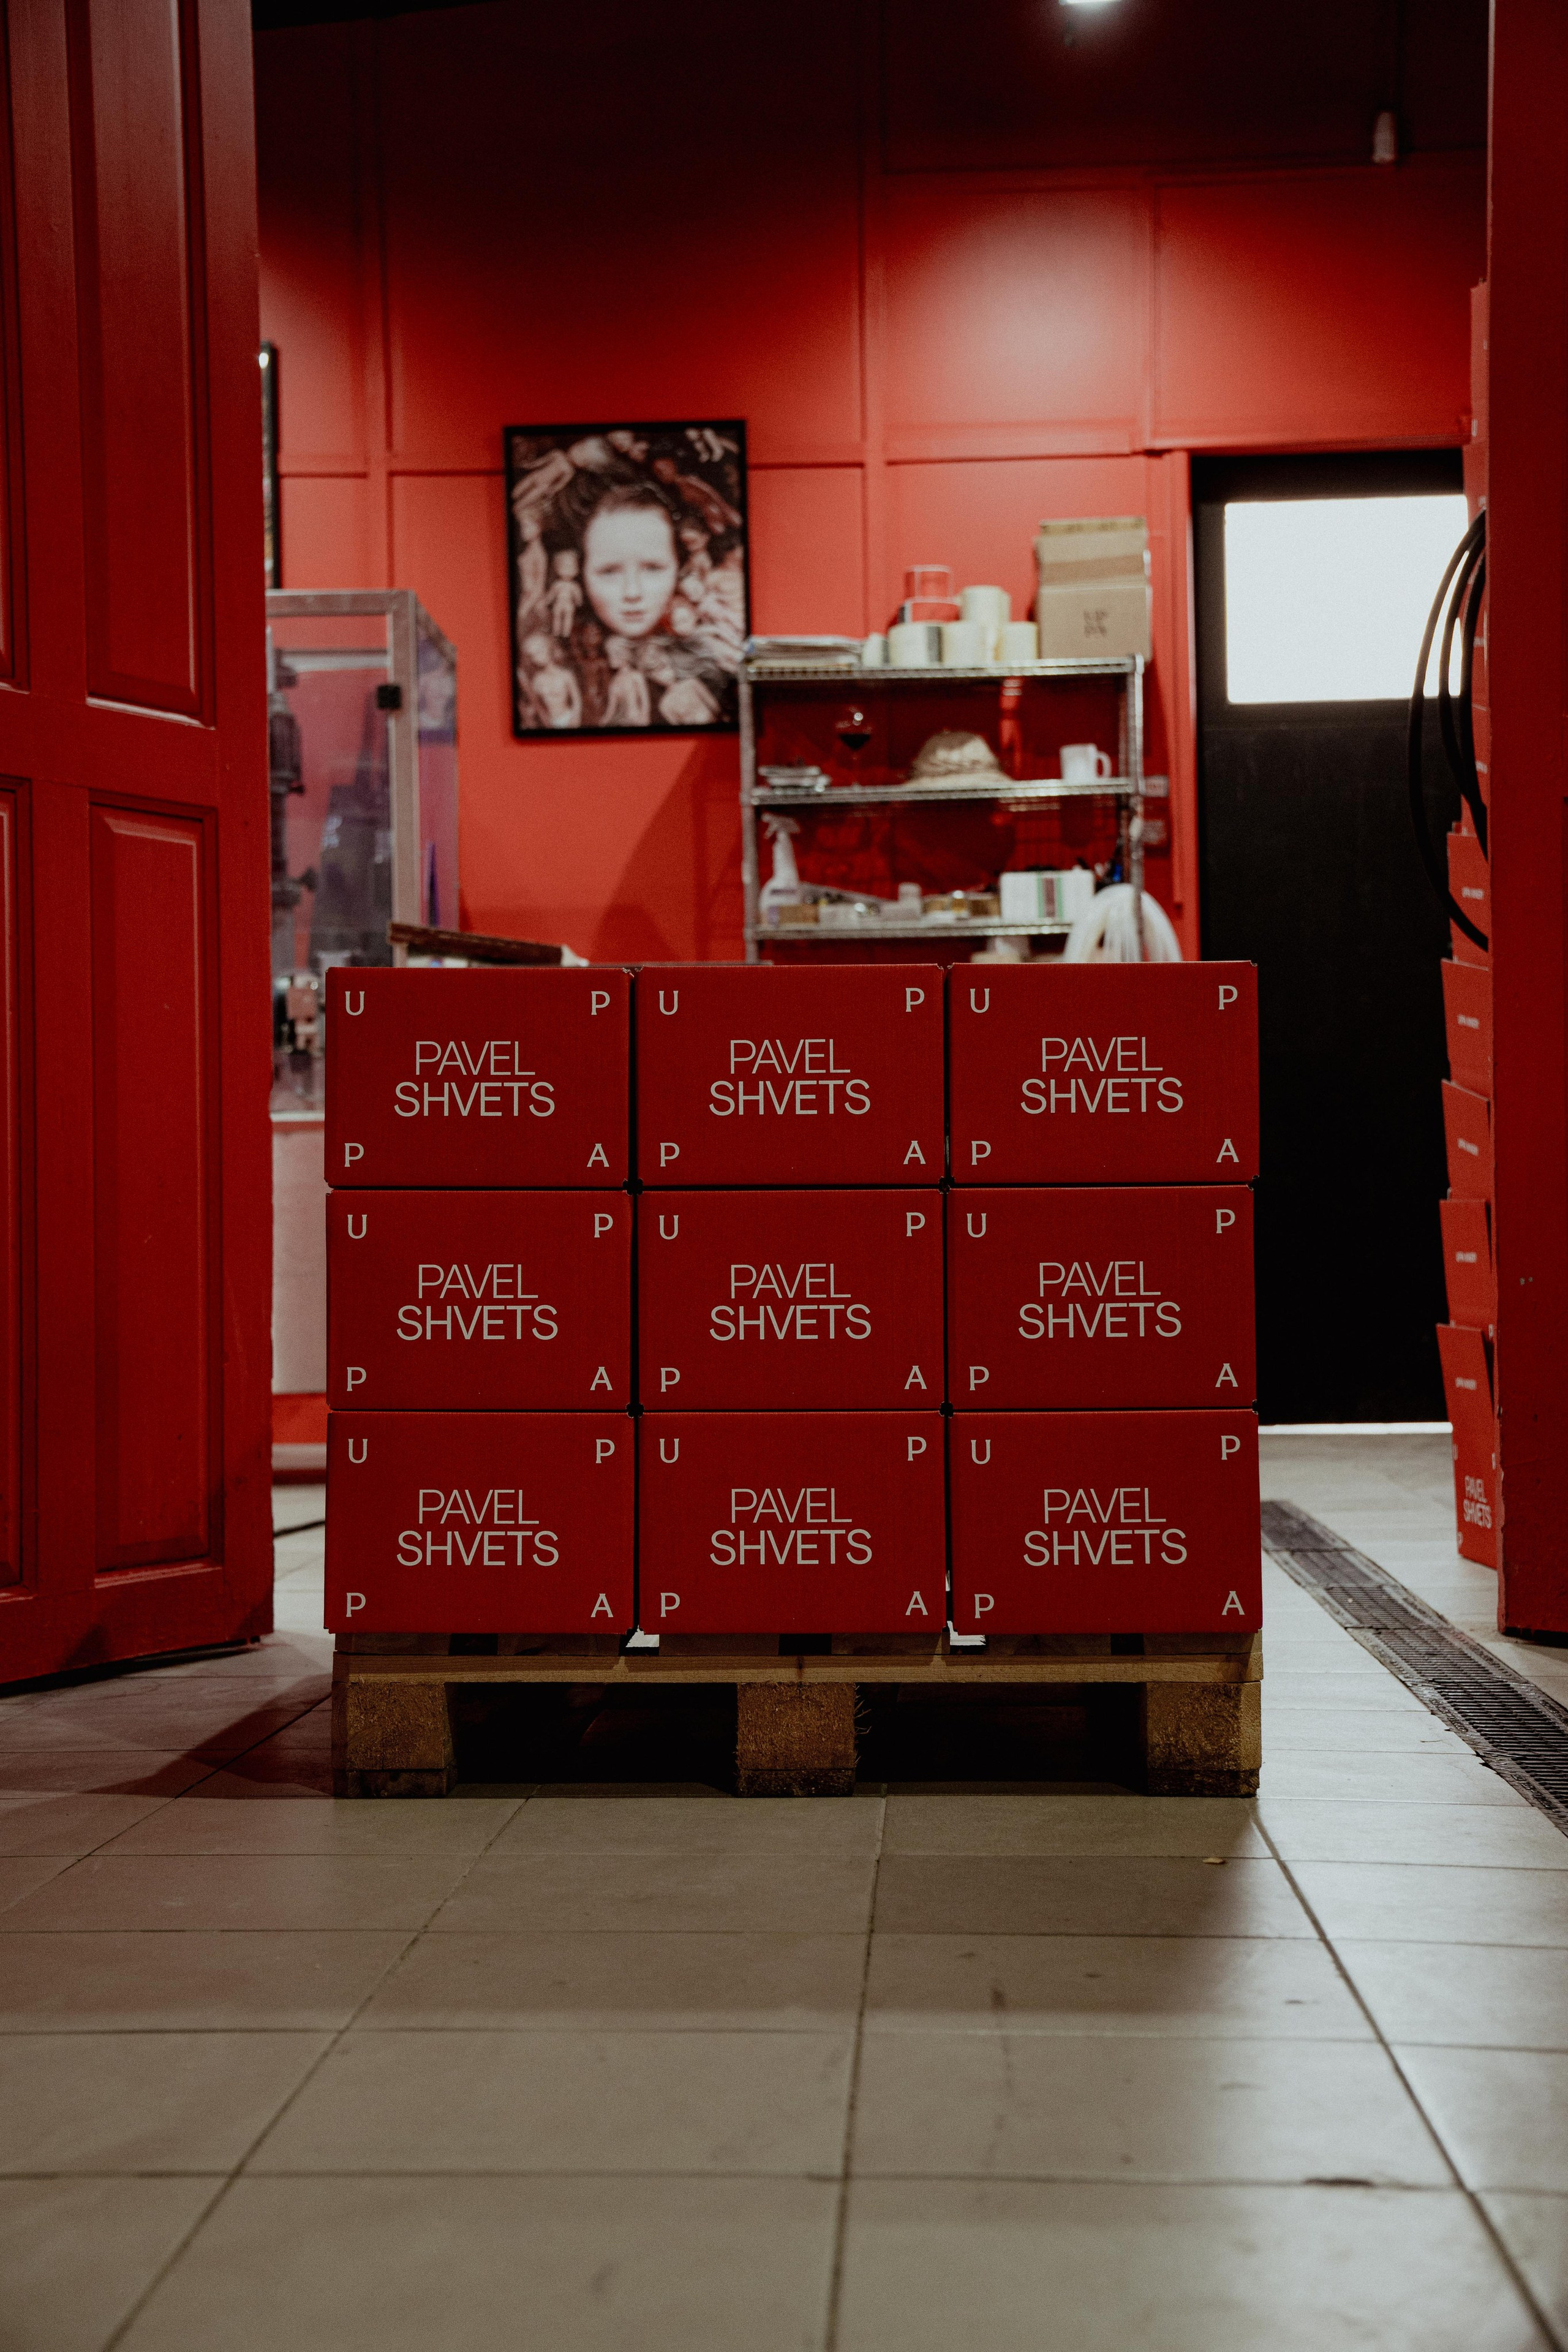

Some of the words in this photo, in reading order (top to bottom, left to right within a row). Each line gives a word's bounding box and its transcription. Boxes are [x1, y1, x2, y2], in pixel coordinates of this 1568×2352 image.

[345, 991, 365, 1016] U
[590, 990, 611, 1016] P
[658, 990, 679, 1016] U
[905, 987, 925, 1012] P
[970, 988, 990, 1014] U
[1218, 985, 1238, 1010] P
[415, 1041, 536, 1076] PAVEL
[730, 1038, 851, 1074] PAVEL
[1042, 1036, 1163, 1072] PAVEL
[394, 1081, 555, 1117] SHVETS
[709, 1079, 871, 1116] SHVETS
[1020, 1077, 1183, 1114] SHVETS
[344, 1142, 364, 1167] P
[586, 1143, 609, 1167] A
[660, 1142, 680, 1167] P
[903, 1140, 926, 1165] A
[971, 1140, 992, 1166] P
[1216, 1138, 1240, 1163] A
[347, 1214, 368, 1239] U
[594, 1213, 614, 1238] P
[658, 1215, 679, 1240] U
[906, 1212, 925, 1237] P
[967, 1213, 987, 1238] U
[1216, 1208, 1235, 1234] P
[418, 1264, 538, 1299] PAVEL
[731, 1263, 851, 1299] PAVEL
[1039, 1261, 1161, 1297] PAVEL
[396, 1305, 558, 1341] SHVETS
[709, 1303, 872, 1341] SHVETS
[1018, 1301, 1182, 1339] SHVETS
[347, 1366, 367, 1392] P
[590, 1366, 613, 1391] A
[660, 1367, 680, 1392] P
[904, 1365, 927, 1390] A
[969, 1366, 989, 1391] P
[1215, 1363, 1238, 1387] A
[348, 1438, 368, 1464] U
[595, 1439, 615, 1464] P
[659, 1438, 680, 1463] U
[907, 1436, 927, 1461] P
[970, 1439, 991, 1464] U
[1221, 1435, 1241, 1460] P
[418, 1489, 540, 1525] PAVEL
[731, 1488, 853, 1523] PAVEL
[1044, 1487, 1167, 1524] PAVEL
[396, 1530, 559, 1567] SHVETS
[709, 1528, 872, 1566] SHVETS
[1023, 1528, 1188, 1567] SHVETS
[345, 1592, 366, 1618] P
[590, 1593, 614, 1618] A
[660, 1592, 680, 1618] P
[905, 1591, 929, 1616] A
[974, 1594, 995, 1619] P
[1221, 1591, 1245, 1616] A
